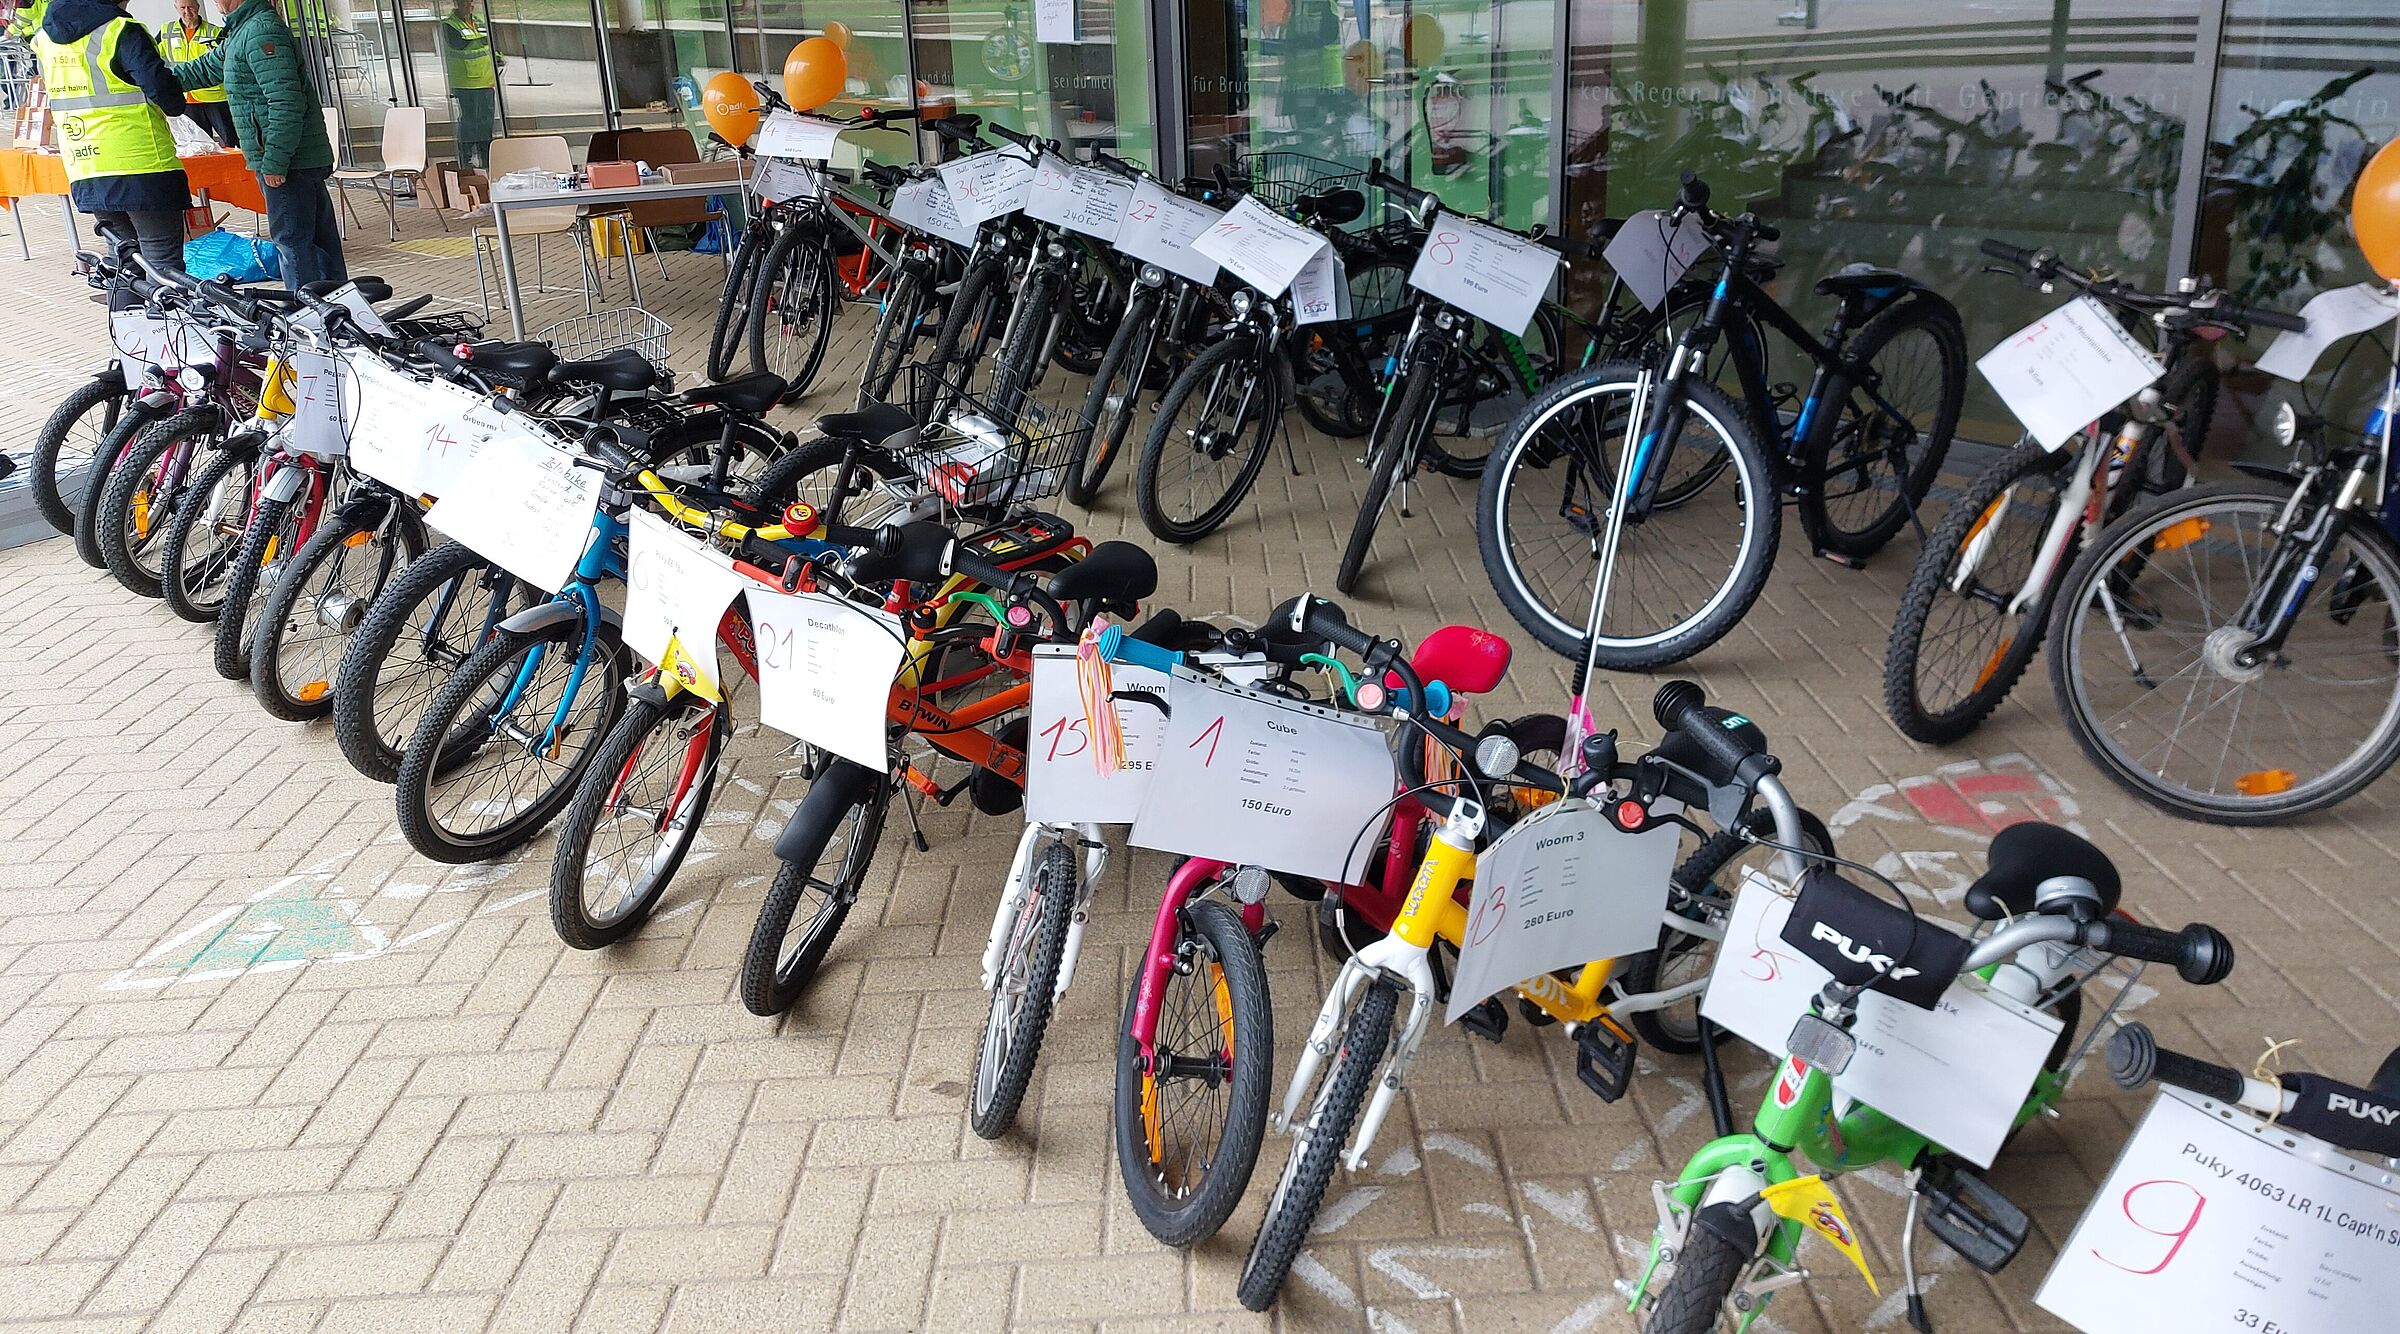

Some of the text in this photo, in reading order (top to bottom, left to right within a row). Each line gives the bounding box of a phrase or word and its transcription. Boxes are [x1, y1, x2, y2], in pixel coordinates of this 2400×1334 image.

[1054, 74, 1069, 89] sei
[1073, 74, 1087, 89] du
[1193, 76, 1213, 93] für
[1635, 80, 1701, 108] Regen
[76, 144, 101, 158] adfc
[955, 176, 980, 201] 36
[1033, 169, 1063, 191] 33
[926, 215, 943, 228] 150
[1062, 208, 1085, 223] 240
[1129, 199, 1158, 224] 27
[1214, 222, 1243, 238] 11
[1429, 231, 1461, 266] 8
[1474, 280, 1489, 294] Euro
[302, 376, 319, 417] 7
[462, 412, 487, 429] Orbea
[425, 423, 458, 459] 14
[807, 617, 847, 637] Decathlon
[759, 621, 795, 672] 21
[821, 689, 836, 706] Euro
[1126, 682, 1167, 695] Woom
[1266, 719, 1299, 736] Cube
[1039, 715, 1088, 764] 15
[1189, 714, 1226, 769] 1
[1120, 760, 1143, 771] 295
[1241, 798, 1293, 817] 150 Euro
[1535, 830, 1586, 852] Woom 3
[1403, 858, 1440, 918] woom
[1469, 884, 1507, 949] 13
[1523, 908, 1575, 930] 280 Euro
[1810, 920, 1922, 983] PUKY
[1739, 947, 1802, 983] 5
[1857, 1036, 1886, 1056] uro
[2325, 1092, 2400, 1127] PUKY
[2181, 1142, 2234, 1180] Puky
[2235, 1170, 2287, 1204] 4063
[2286, 1192, 2314, 1216] LR
[2316, 1201, 2334, 1226] 1L
[2336, 1211, 2387, 1246] Capt'n
[2090, 1179, 2208, 1276] 9
[2233, 1308, 2261, 1329] 33
